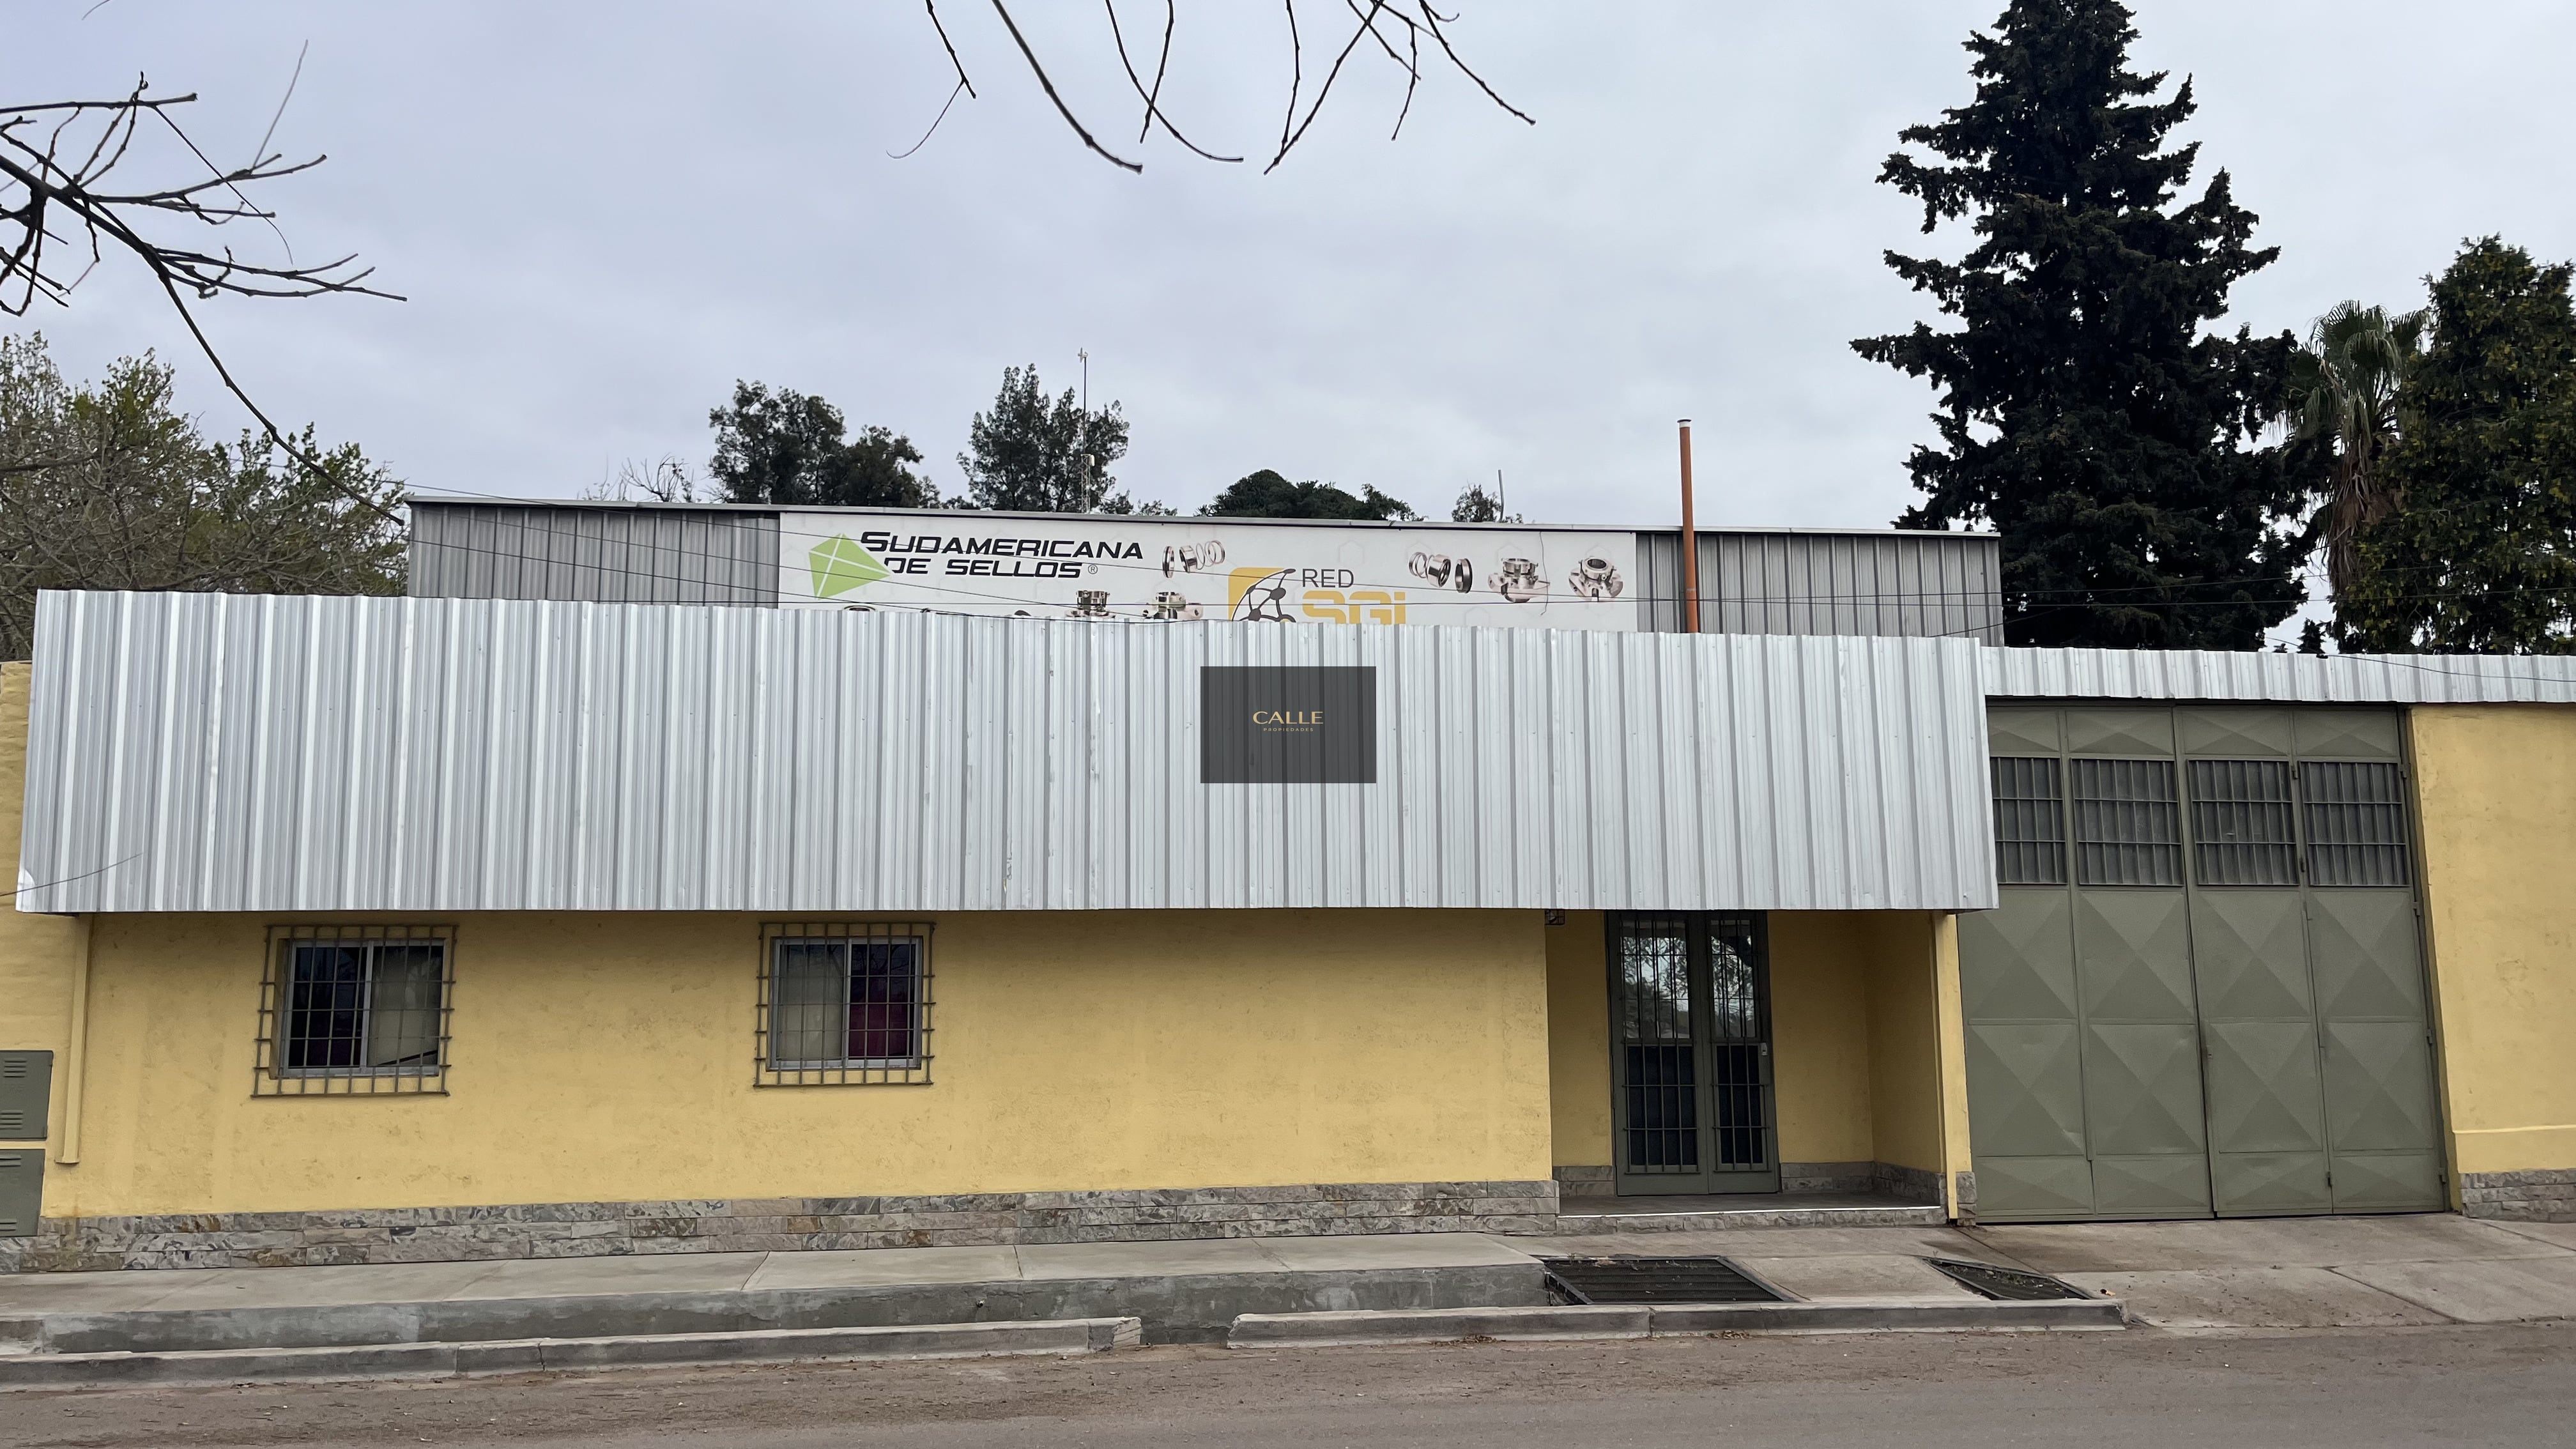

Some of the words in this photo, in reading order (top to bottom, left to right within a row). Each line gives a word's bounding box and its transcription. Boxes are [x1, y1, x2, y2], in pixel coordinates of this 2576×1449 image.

[861, 531, 1143, 560] SUDAMERICANA
[884, 557, 931, 574] DE
[1302, 568, 1354, 588] RED
